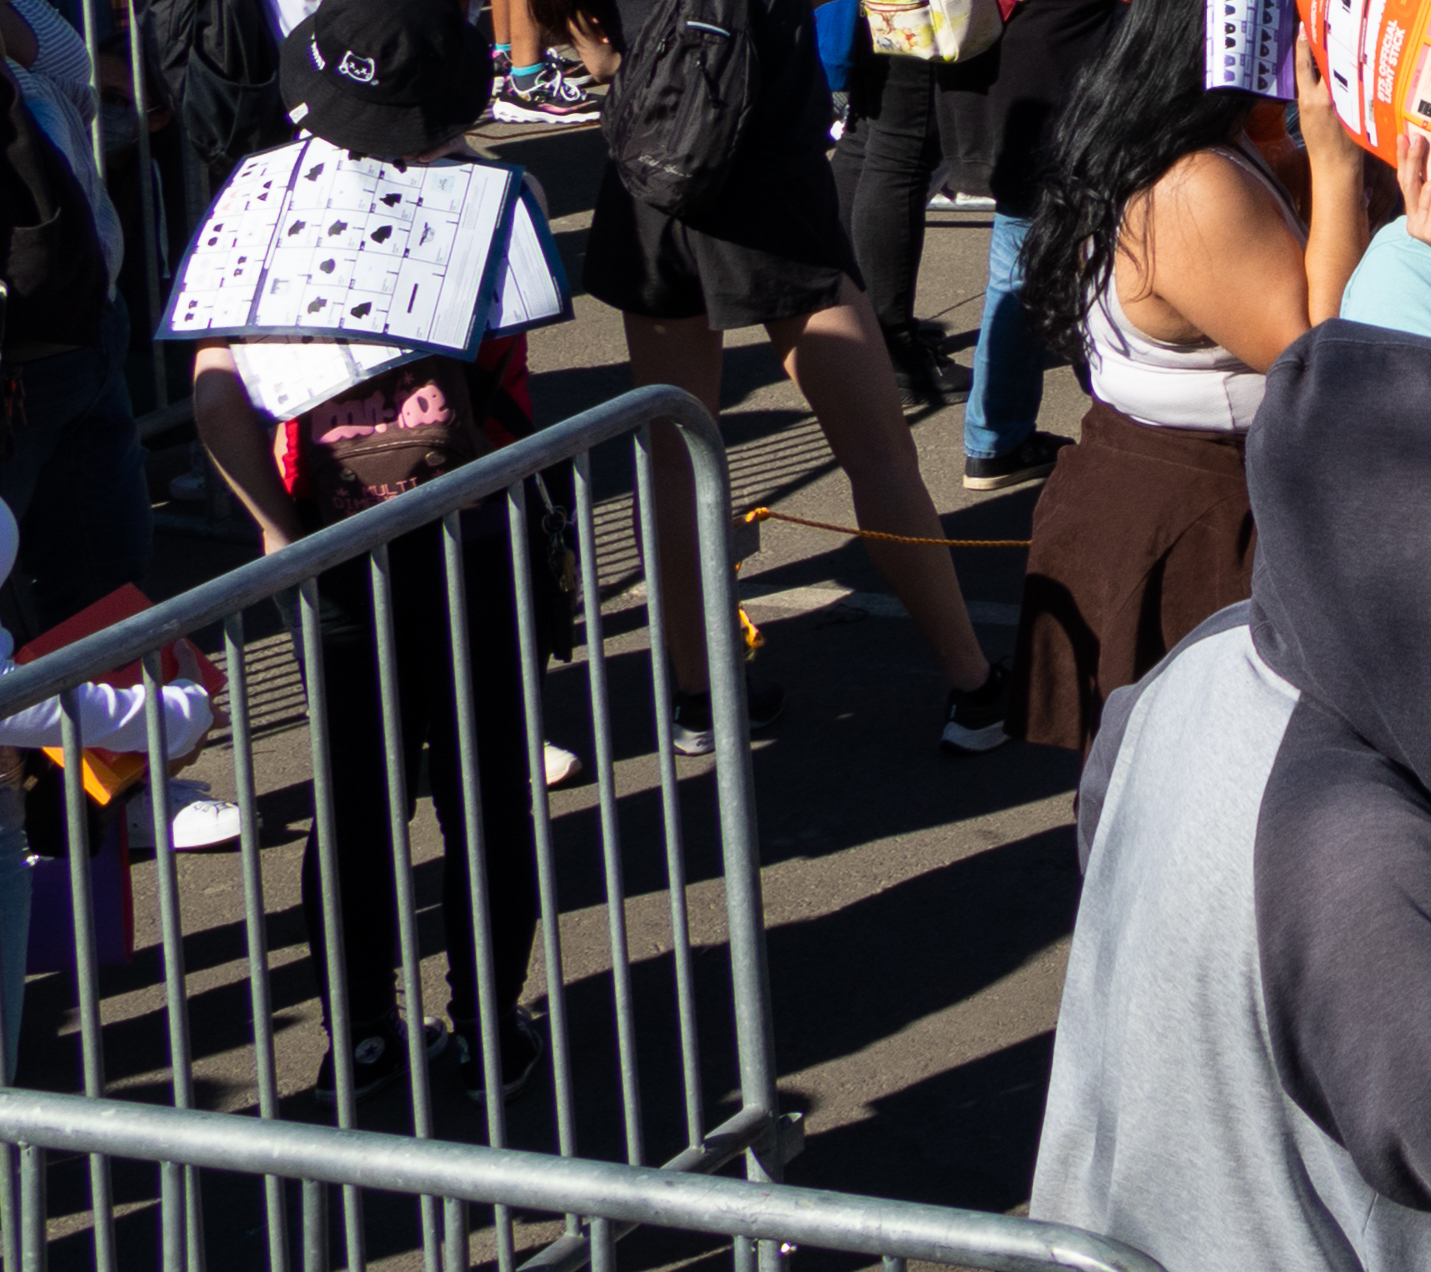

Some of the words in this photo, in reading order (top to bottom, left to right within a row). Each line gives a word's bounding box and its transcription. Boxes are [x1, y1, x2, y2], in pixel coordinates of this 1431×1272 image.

[1380, 19, 1398, 77] OFFICIAL
[1389, 28, 1406, 67] STICK
[1376, 78, 1388, 102] BTS
[1384, 69, 1397, 104] LIGHT
[363, 476, 418, 496] MULTI
